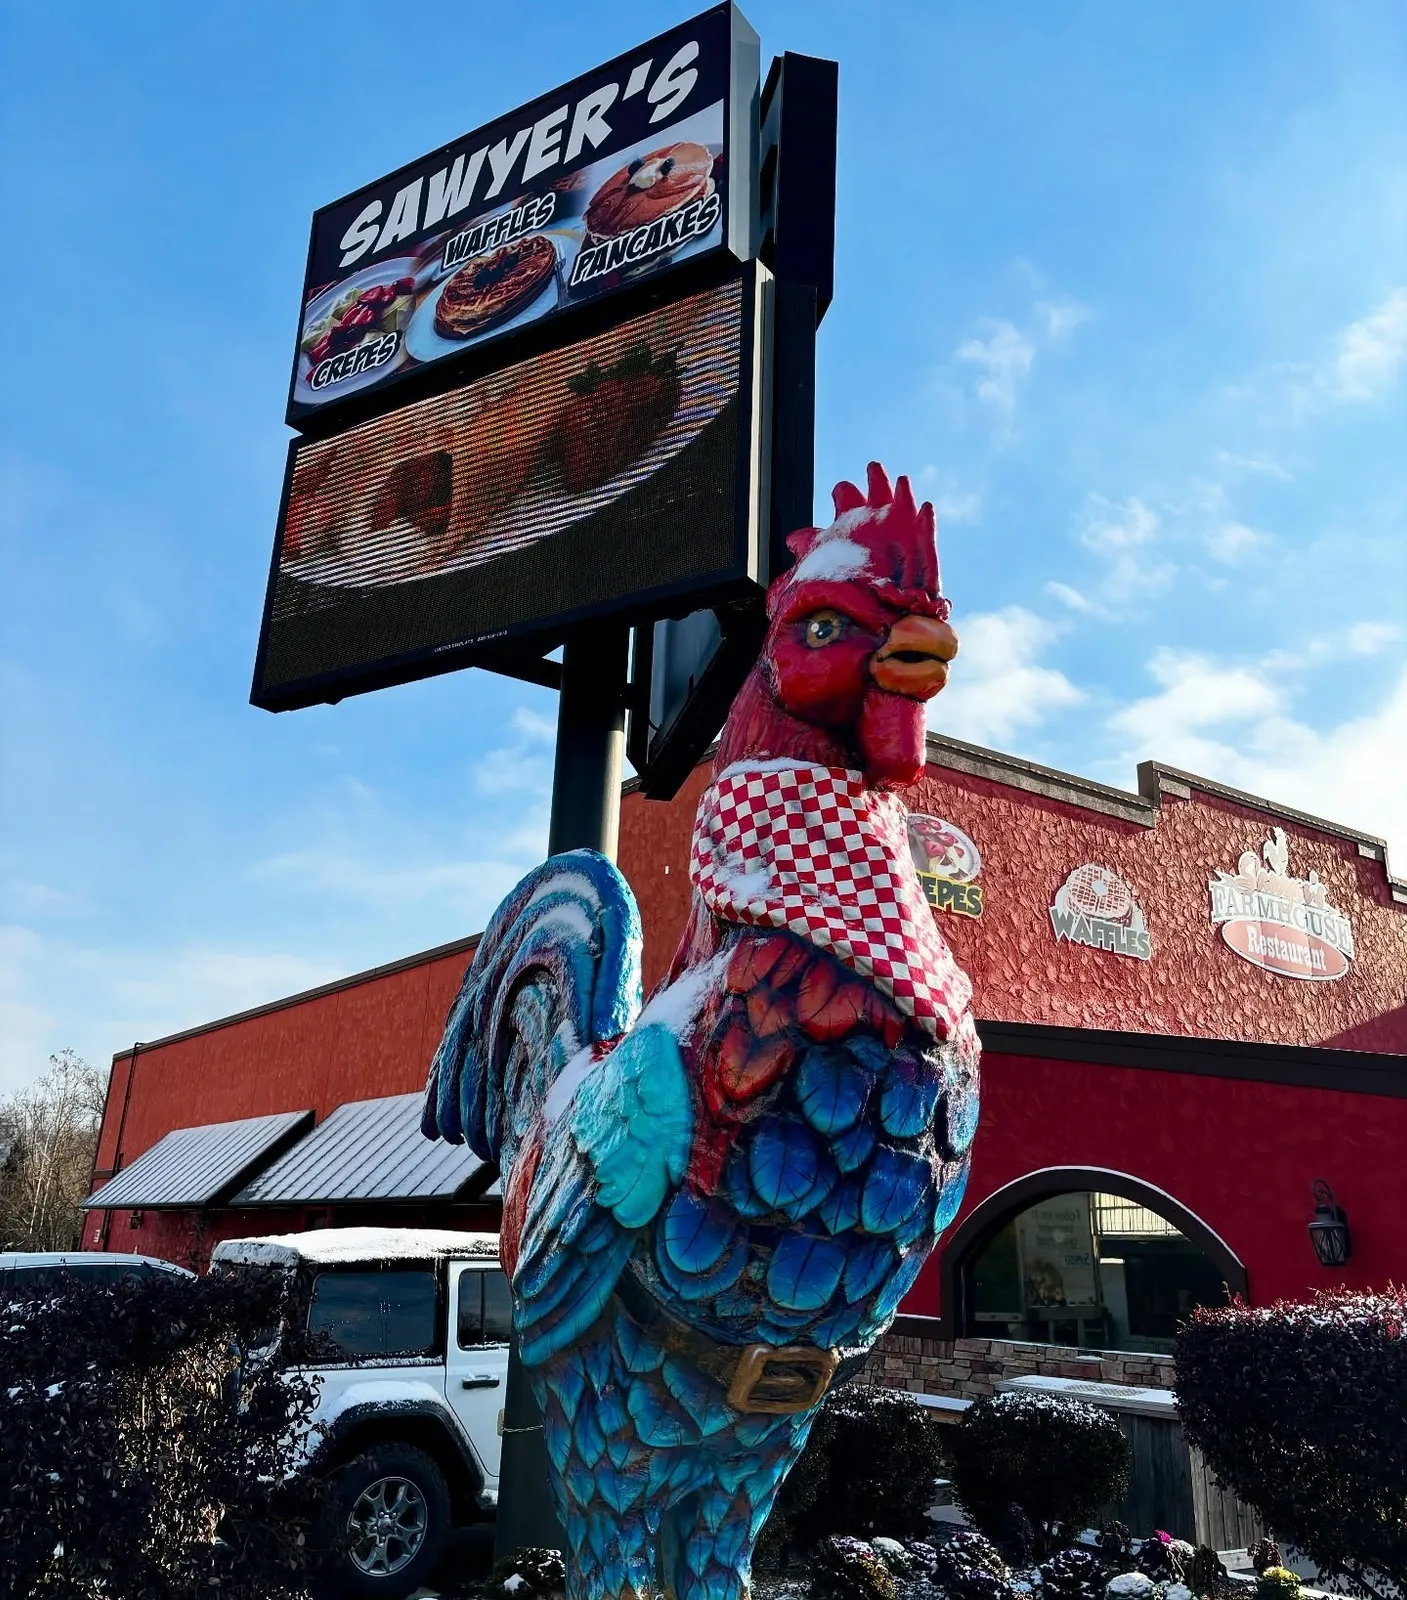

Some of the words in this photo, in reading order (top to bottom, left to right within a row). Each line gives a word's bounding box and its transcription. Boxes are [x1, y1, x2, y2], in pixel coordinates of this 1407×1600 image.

[339, 41, 700, 268] SAWYER'S
[442, 192, 556, 269] WAFFLES
[568, 194, 720, 288] PANCAKES
[310, 333, 398, 391] CREPES
[916, 871, 983, 918] EPES
[1212, 884, 1353, 953] FARMHOUSE
[1049, 905, 1151, 960] WAFFLES
[1246, 925, 1327, 971] Restaurant
